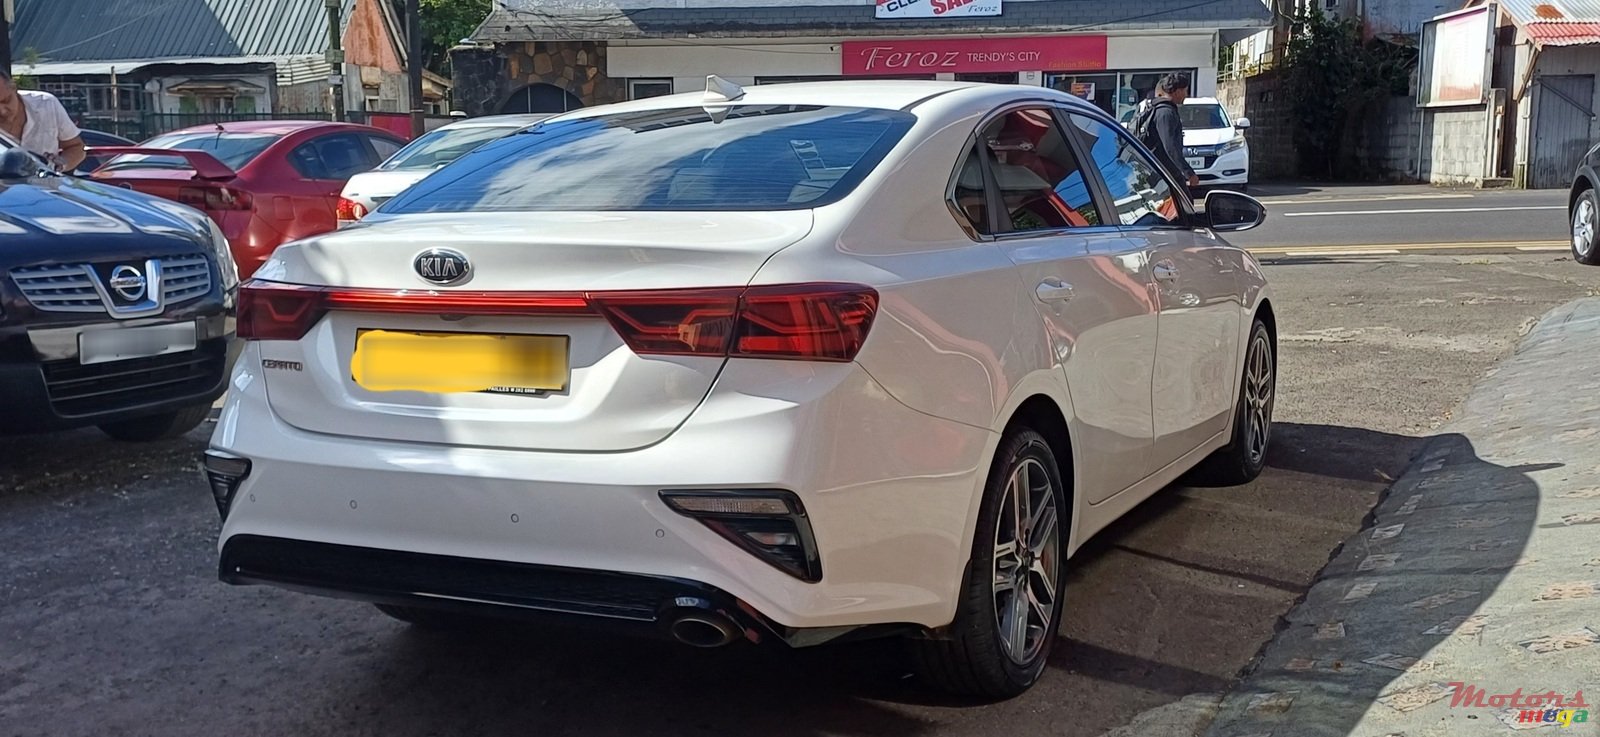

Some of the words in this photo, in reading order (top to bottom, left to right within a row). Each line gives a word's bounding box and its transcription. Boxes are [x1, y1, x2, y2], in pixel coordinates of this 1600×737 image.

[860, 47, 959, 71] Feroz
[967, 52, 1016, 63] TRENDY'S
[1017, 51, 1041, 62] CITY
[420, 257, 458, 277] KIA
